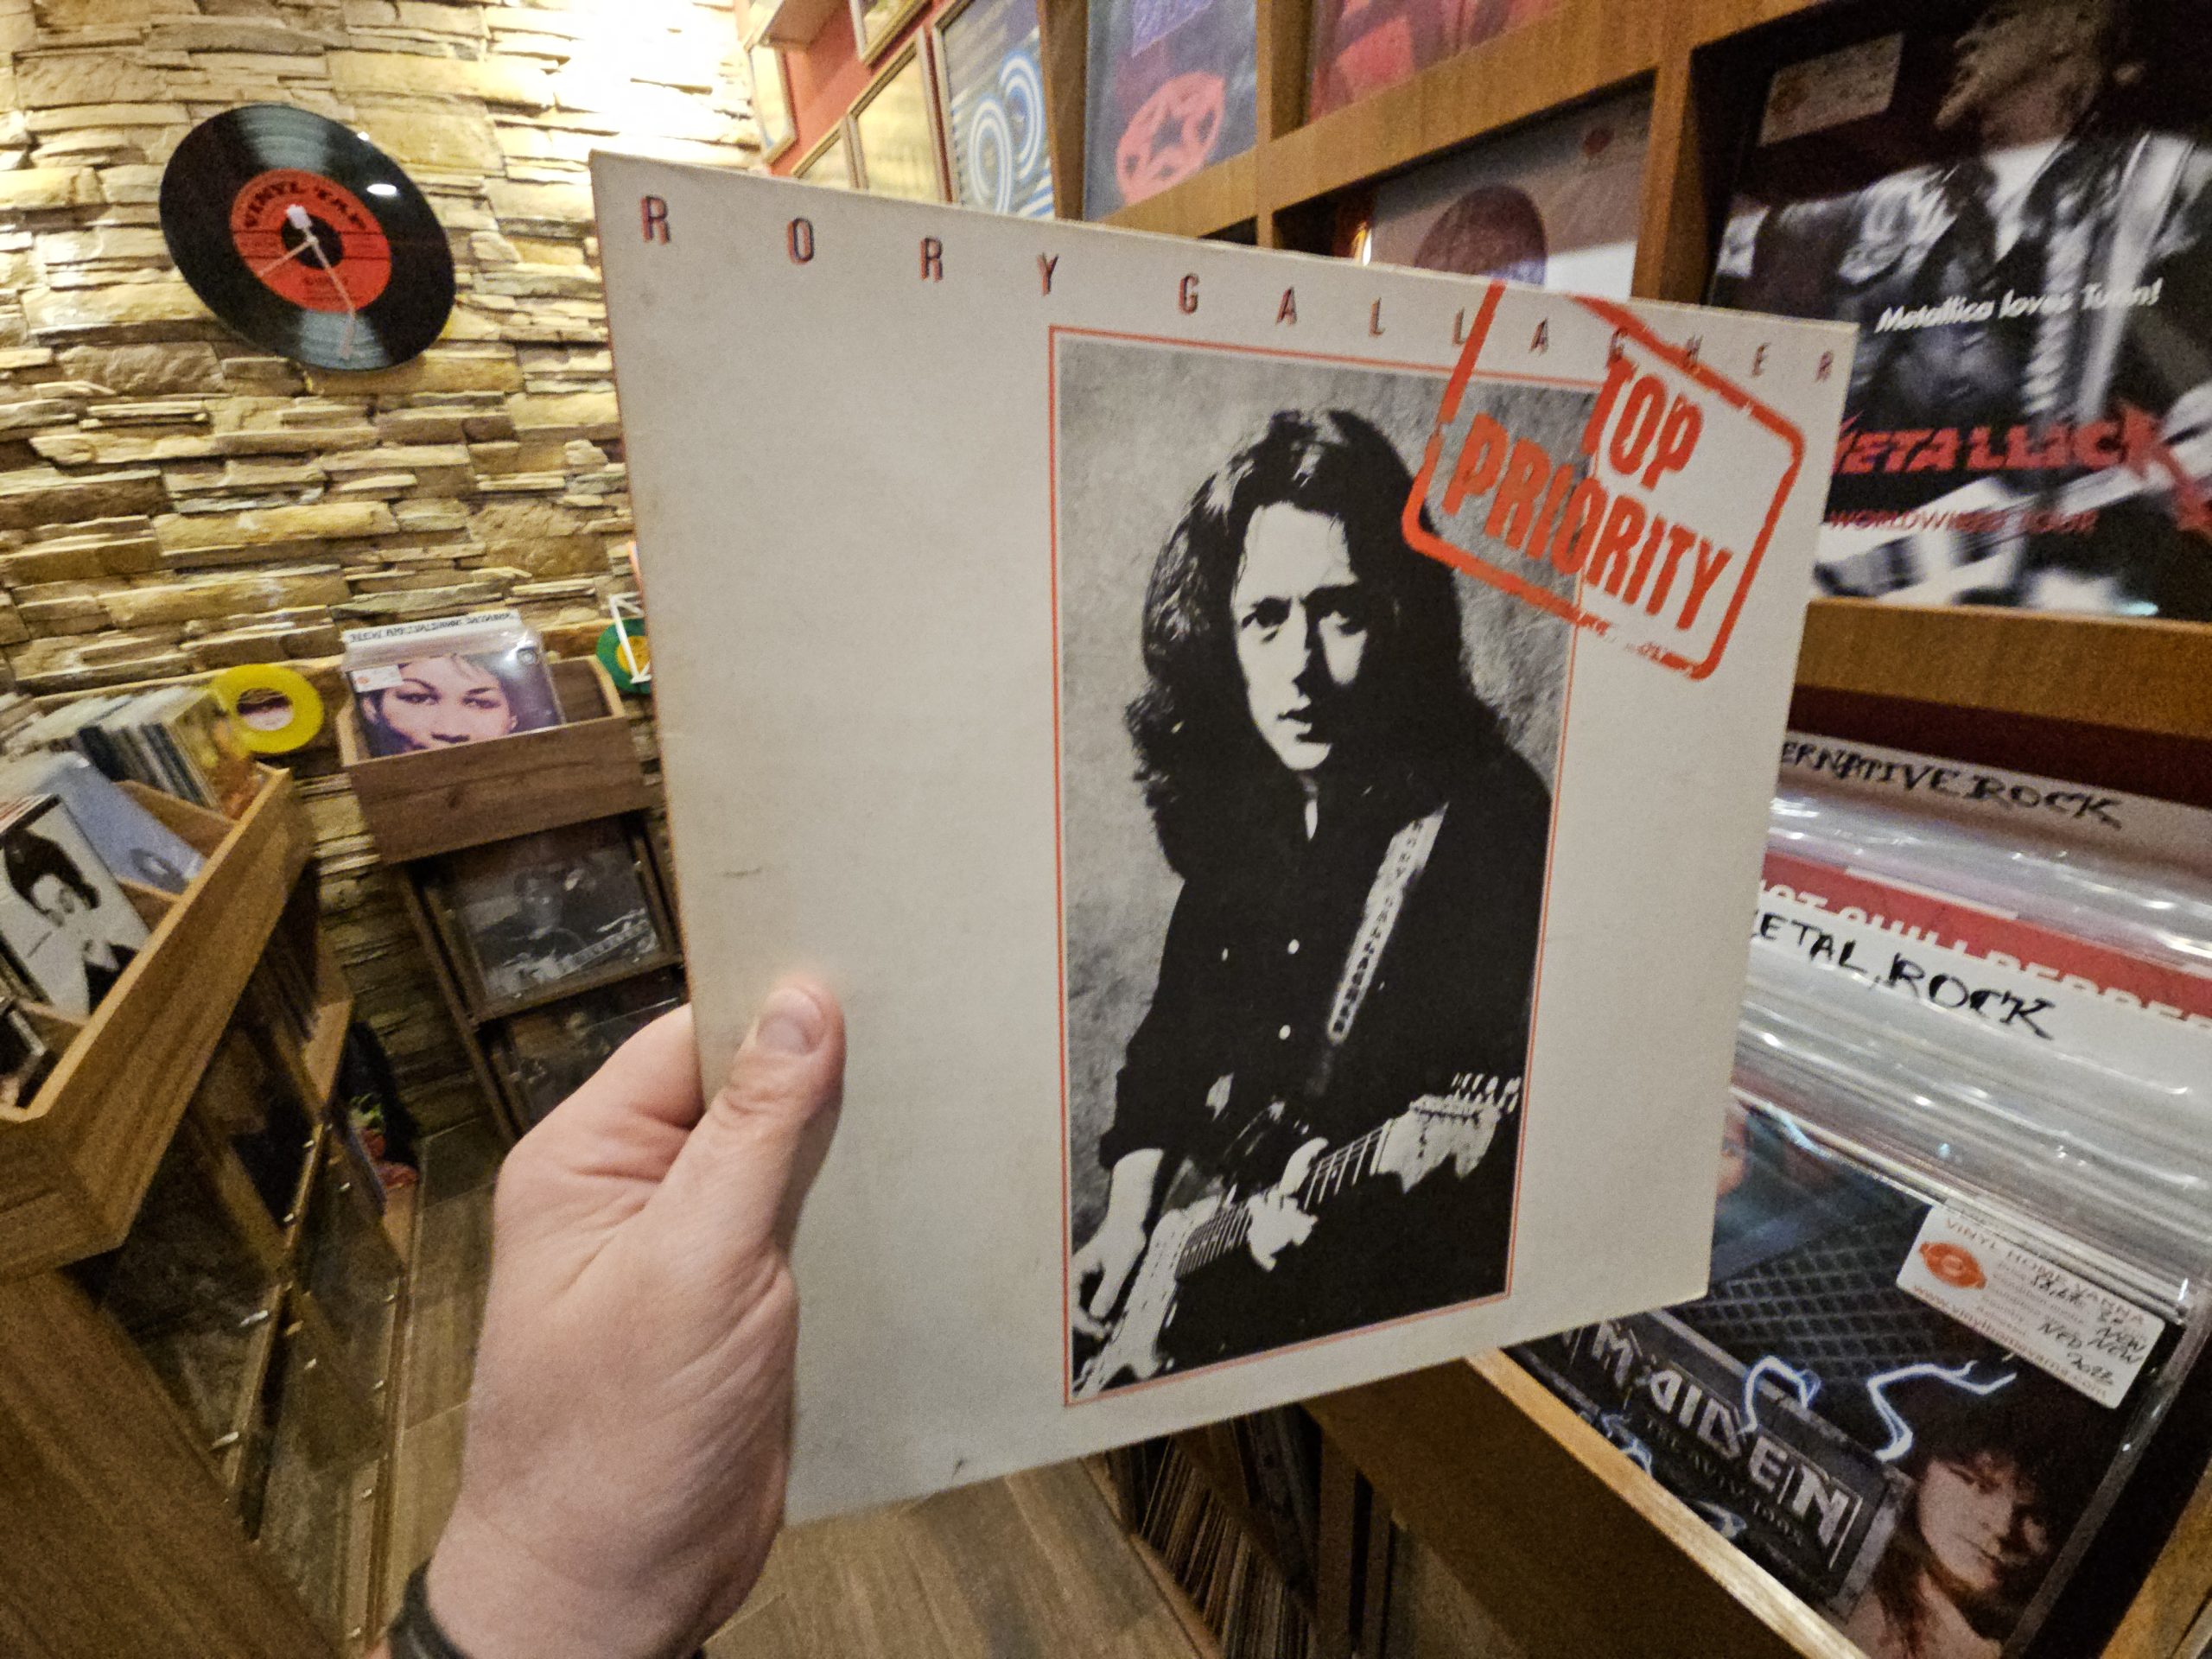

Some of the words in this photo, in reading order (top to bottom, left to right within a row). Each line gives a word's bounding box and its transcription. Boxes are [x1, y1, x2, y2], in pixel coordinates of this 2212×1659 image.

[640, 195, 1059, 298] RORY
[1177, 272, 1835, 385] GALLAGHER
[1874, 295, 1995, 334] Metallica
[1998, 289, 2074, 319] loves
[1582, 356, 1704, 492] TOP
[1441, 412, 1733, 632] PRIORITY
[1782, 741, 1961, 796] ERNATIVE
[1964, 773, 2124, 830] ROCK
[1751, 910, 1880, 989] ETAL,
[1885, 951, 2056, 1041] ROCK
[1944, 1217, 1997, 1250] VINYL
[1591, 1319, 1849, 1547] MAIDEN
